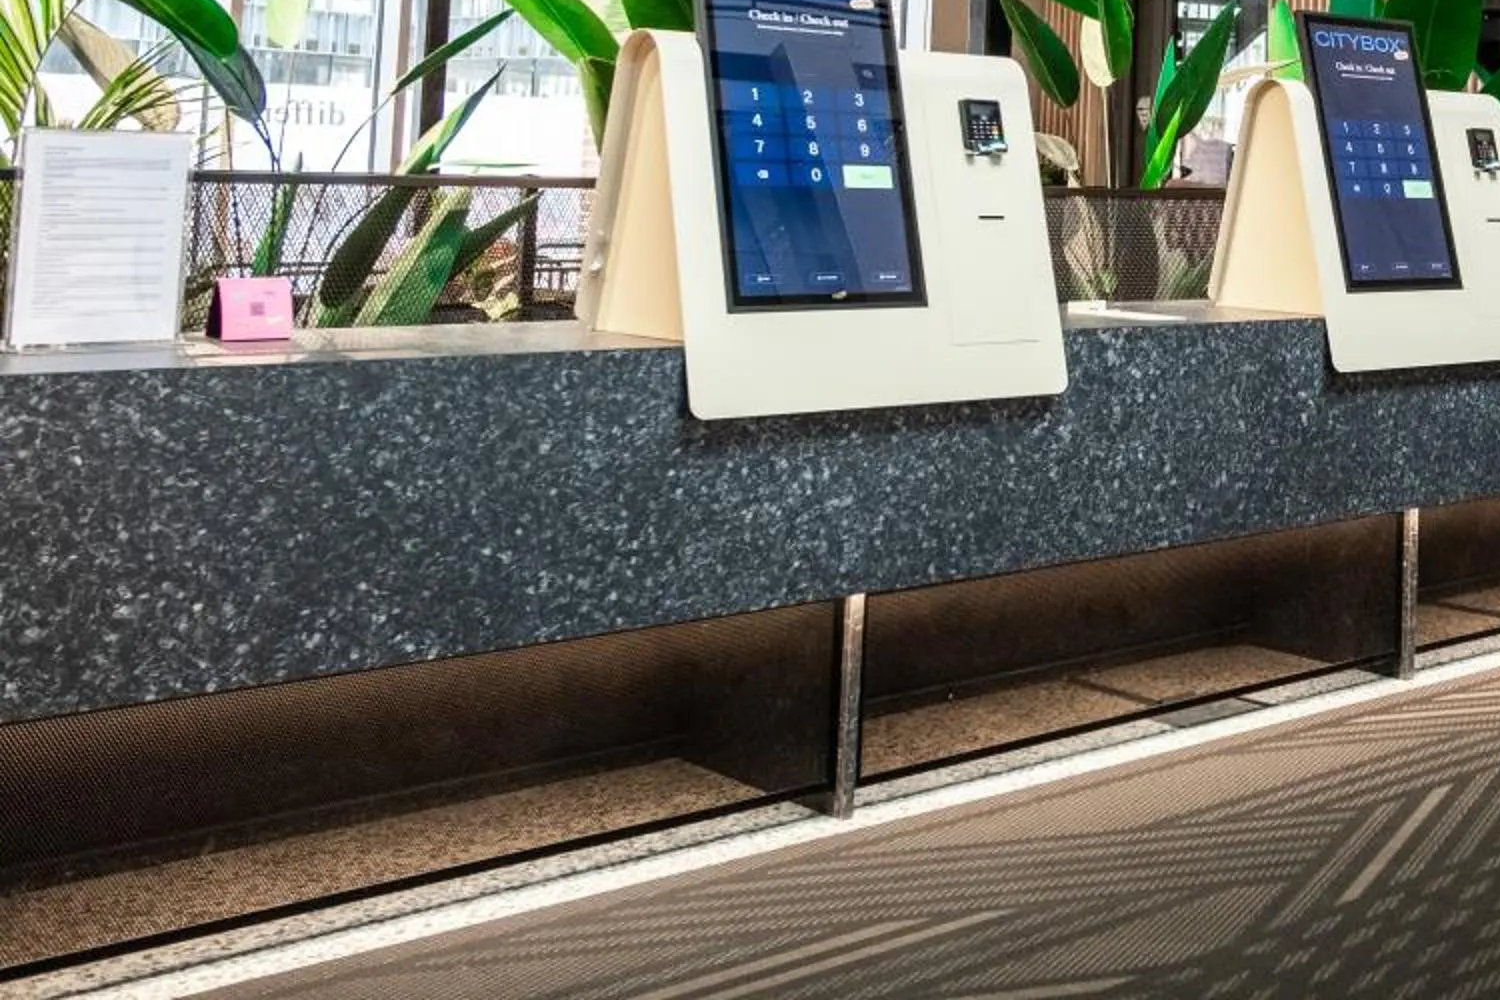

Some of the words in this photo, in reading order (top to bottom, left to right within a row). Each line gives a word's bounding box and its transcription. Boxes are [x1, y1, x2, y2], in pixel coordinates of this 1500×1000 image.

[1315, 31, 1399, 53] CITYBOX
[752, 87, 759, 101] 1
[803, 90, 813, 104] 2
[854, 93, 865, 107] 3
[752, 113, 763, 127] 4
[805, 115, 816, 129] 5
[857, 118, 867, 132] 6
[754, 139, 765, 153] 7
[808, 141, 819, 156] 8
[860, 143, 870, 157] 9
[811, 167, 822, 182] 0
